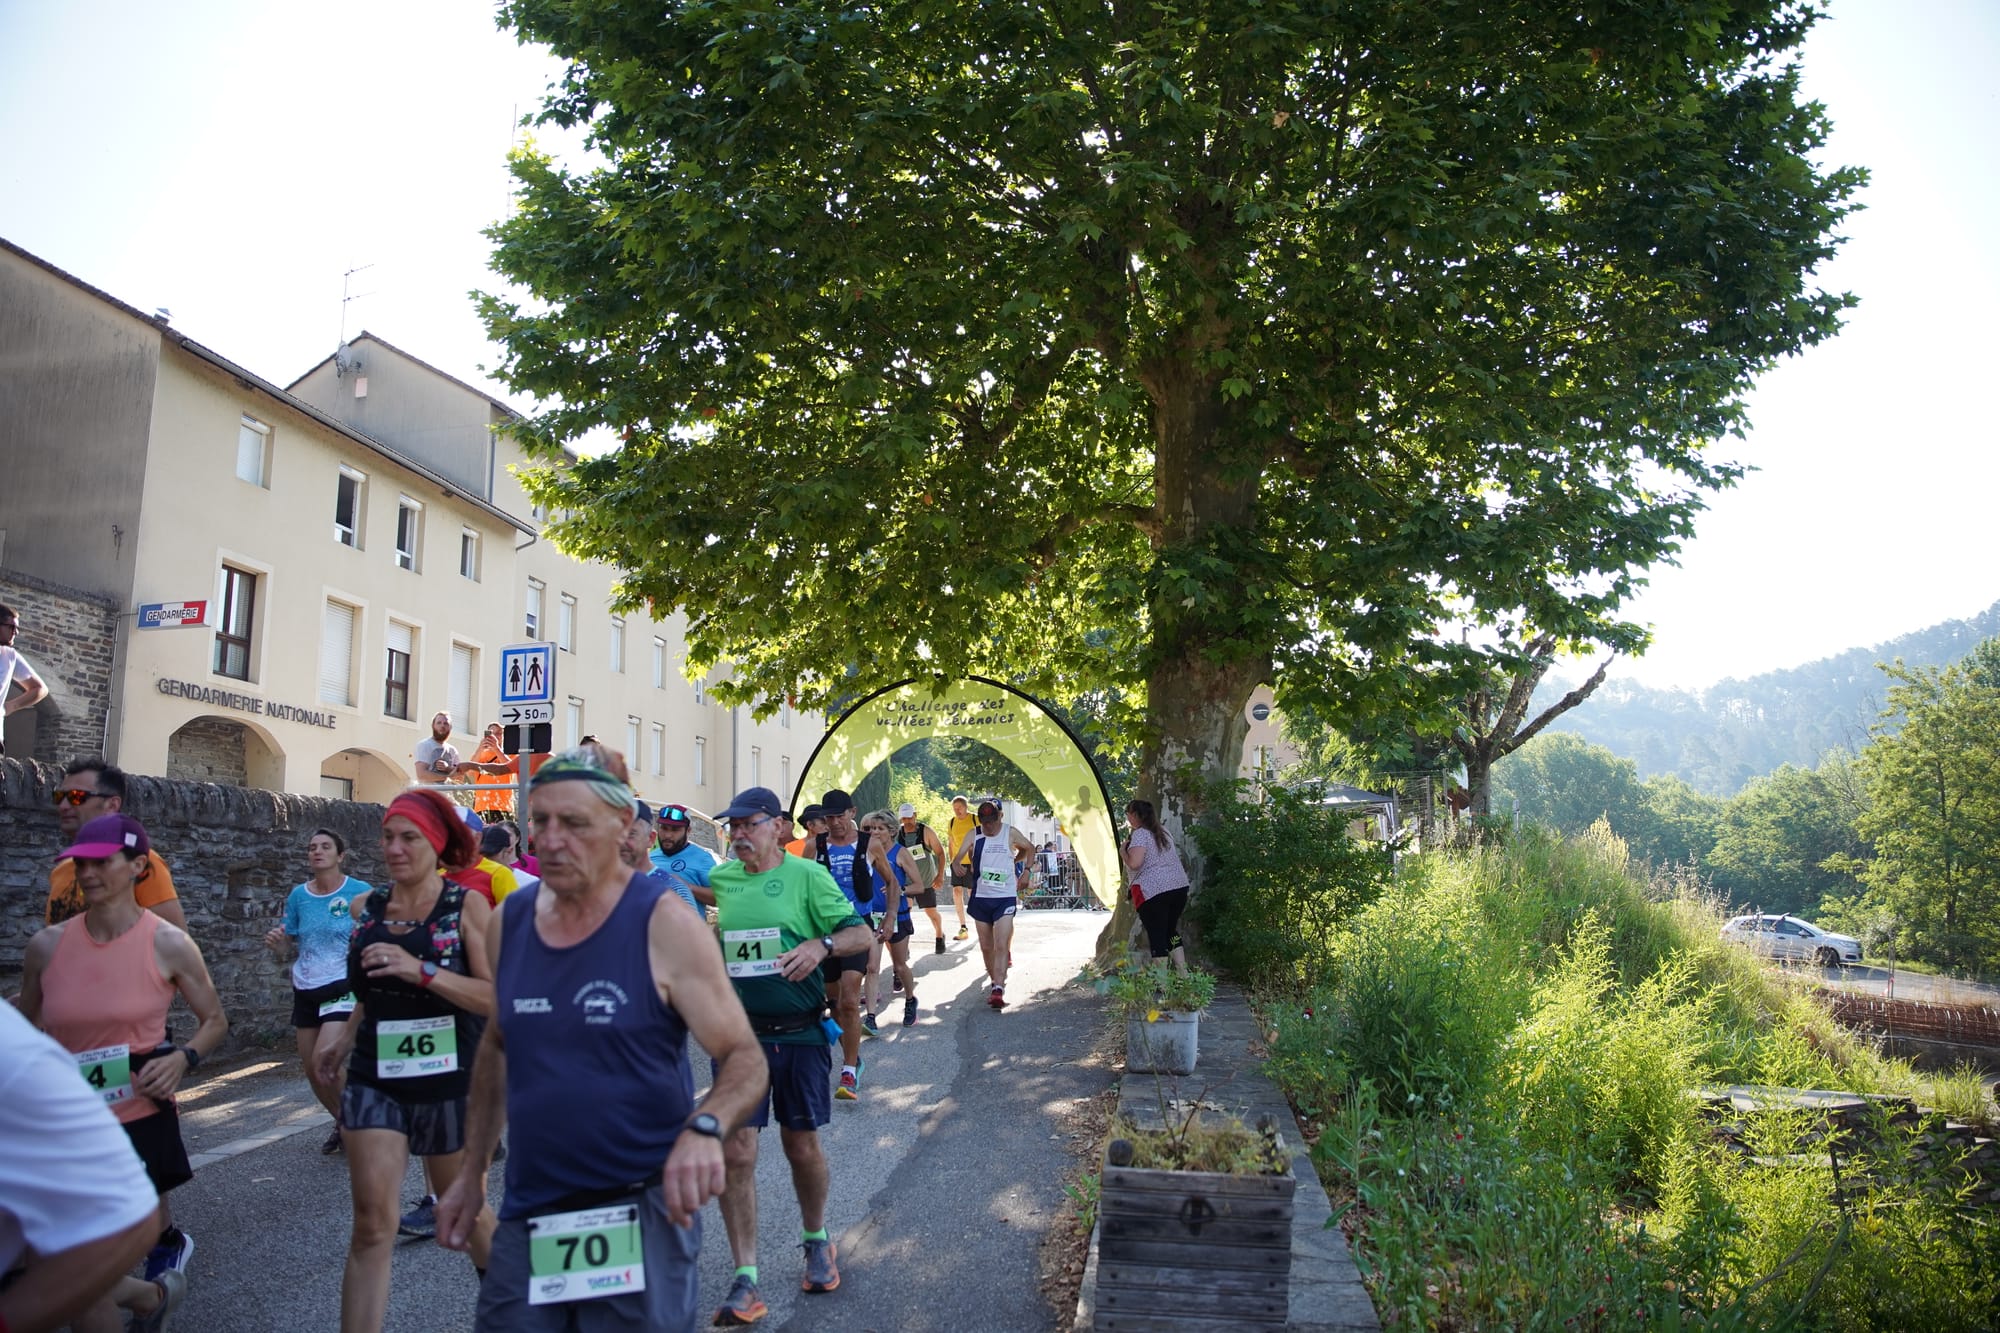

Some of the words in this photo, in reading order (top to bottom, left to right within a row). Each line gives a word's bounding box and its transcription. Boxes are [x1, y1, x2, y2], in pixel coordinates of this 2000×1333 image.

[147, 607, 198, 622] GENDARMERIE
[157, 677, 263, 715] GENDARMERIE
[265, 701, 337, 730] NATIONALE
[886, 700, 967, 715] Challenge
[978, 698, 1005, 710] des
[876, 714, 932, 726] vallées
[944, 713, 1014, 726] cévenoles
[988, 872, 1001, 882] 72
[736, 942, 763, 961] 41
[396, 1033, 436, 1058] 46
[556, 1233, 610, 1271] 70
